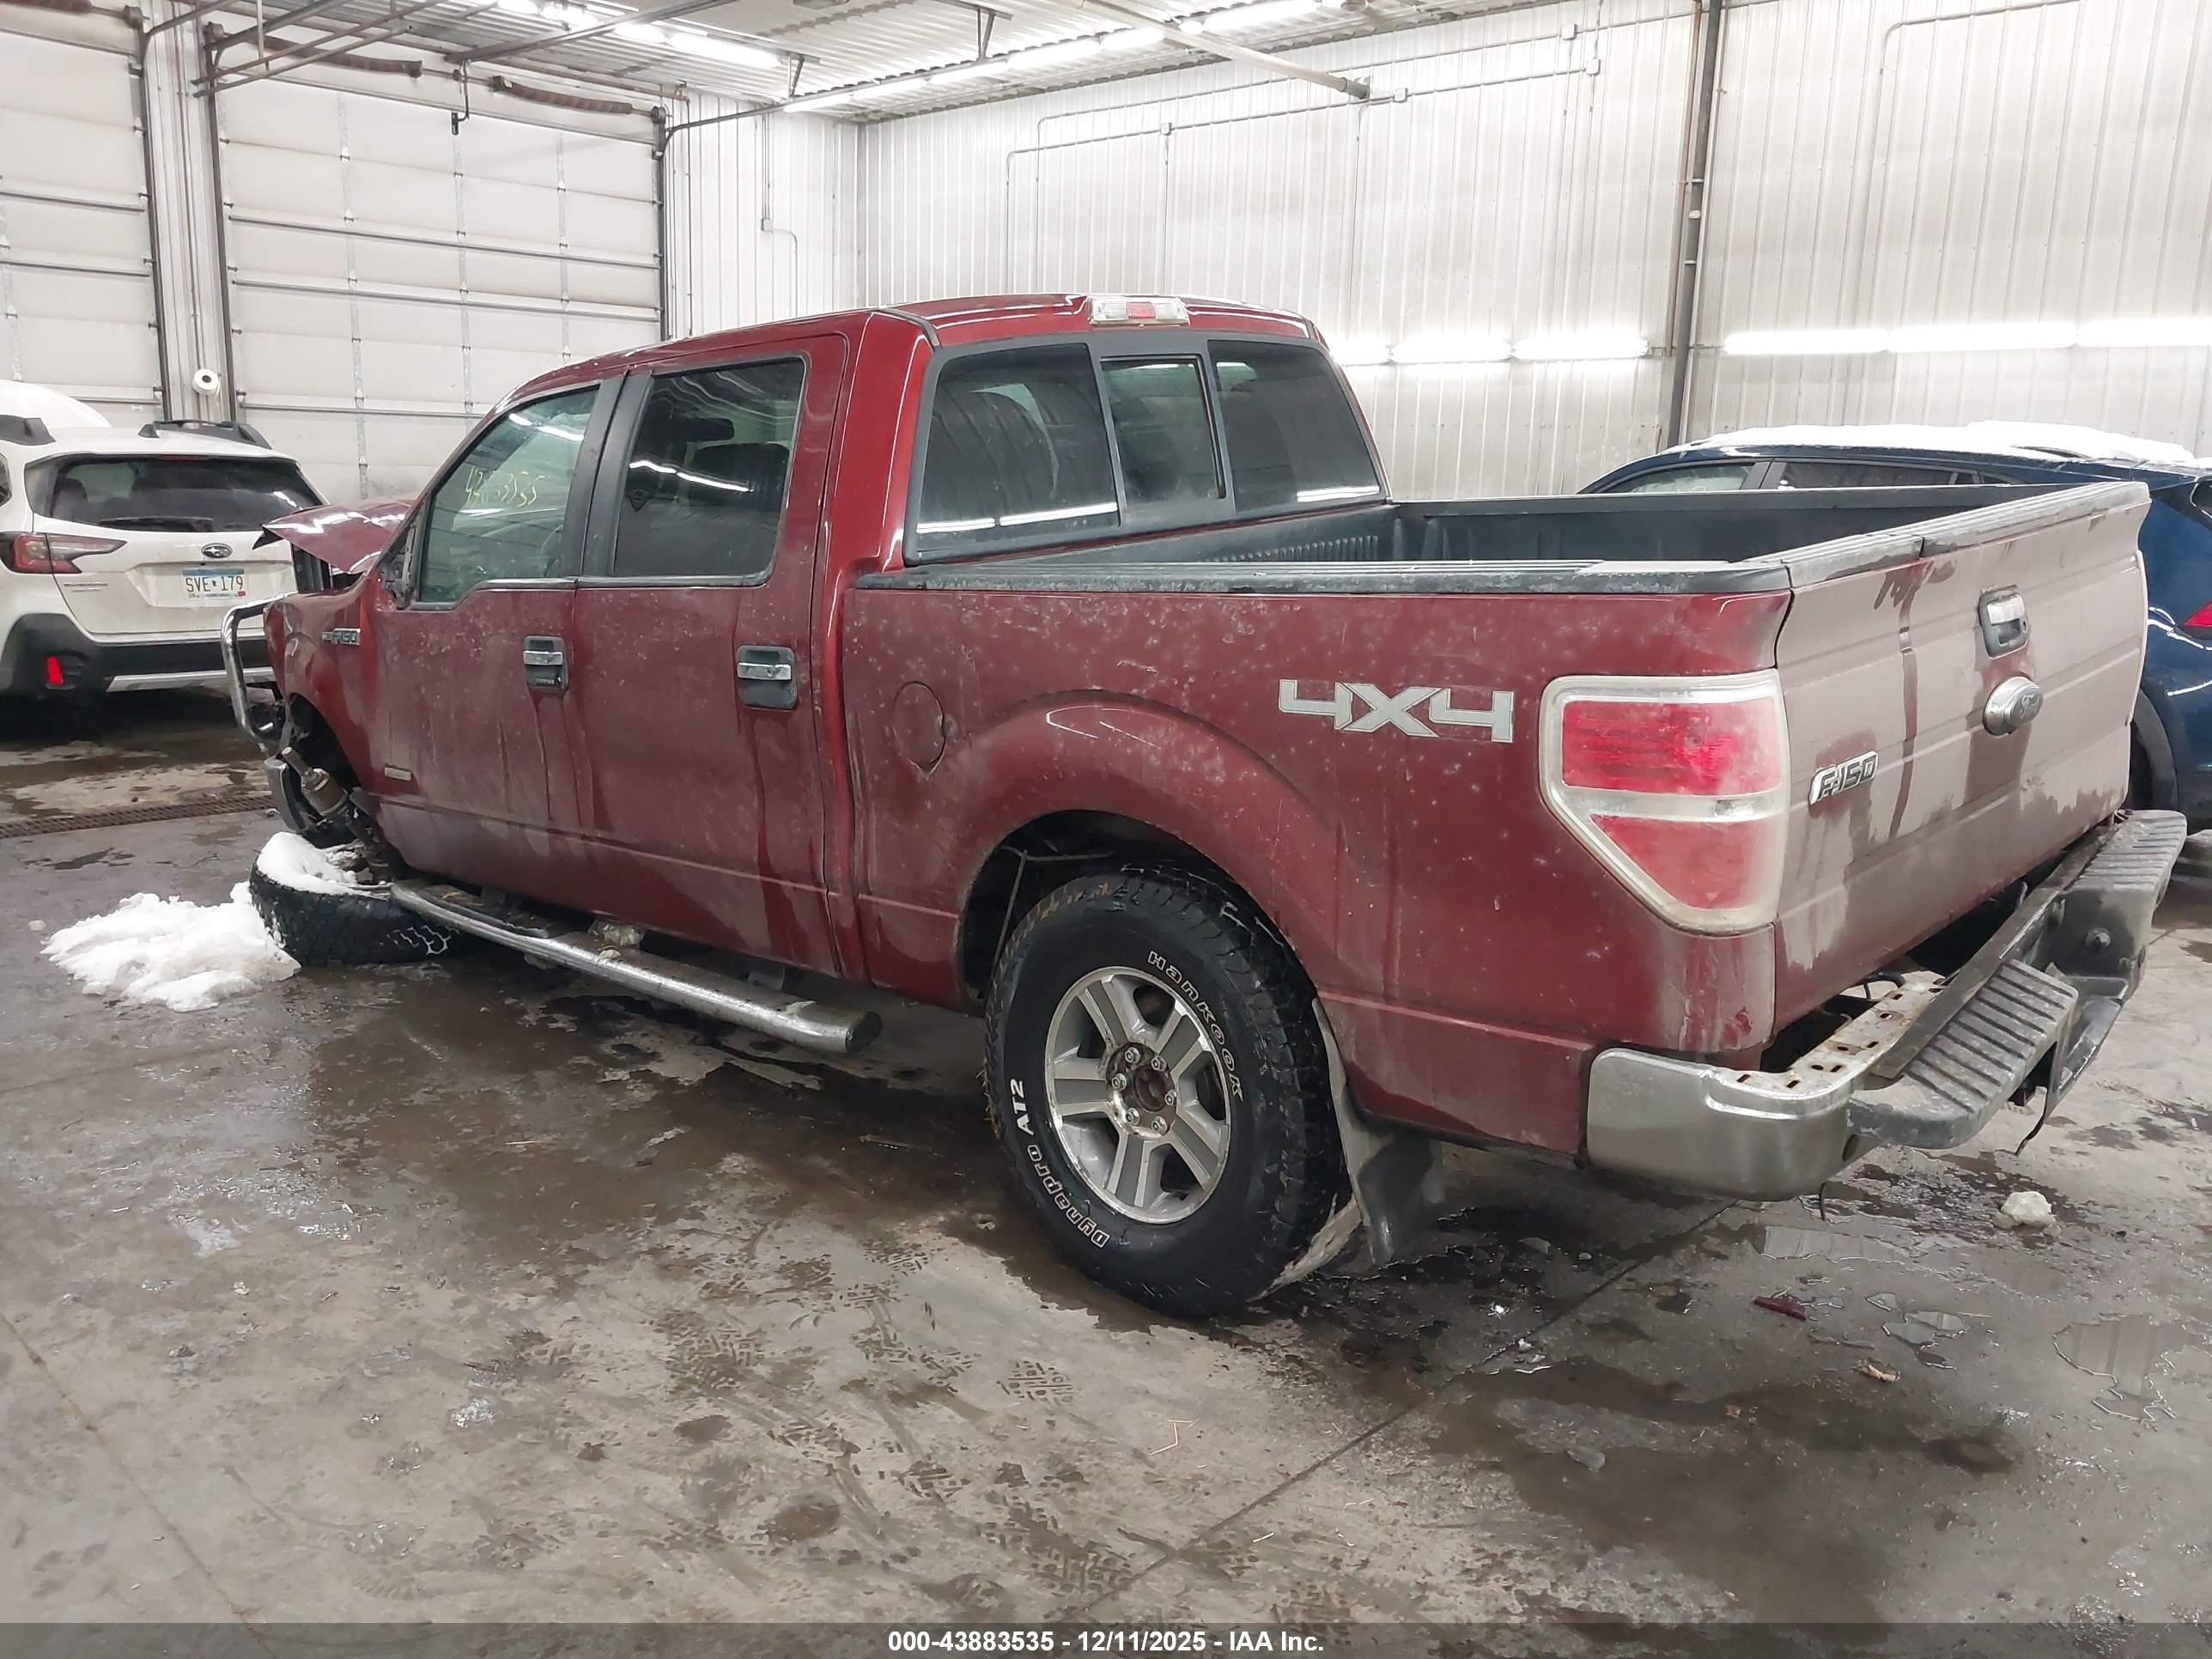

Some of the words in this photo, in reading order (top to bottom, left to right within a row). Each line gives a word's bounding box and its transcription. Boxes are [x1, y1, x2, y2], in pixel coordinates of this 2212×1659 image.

[185, 577, 211, 592] SVE
[221, 576, 244, 591] 179
[1010, 1078, 1035, 1136] AT2
[1027, 1144, 1110, 1249] Dynapro
